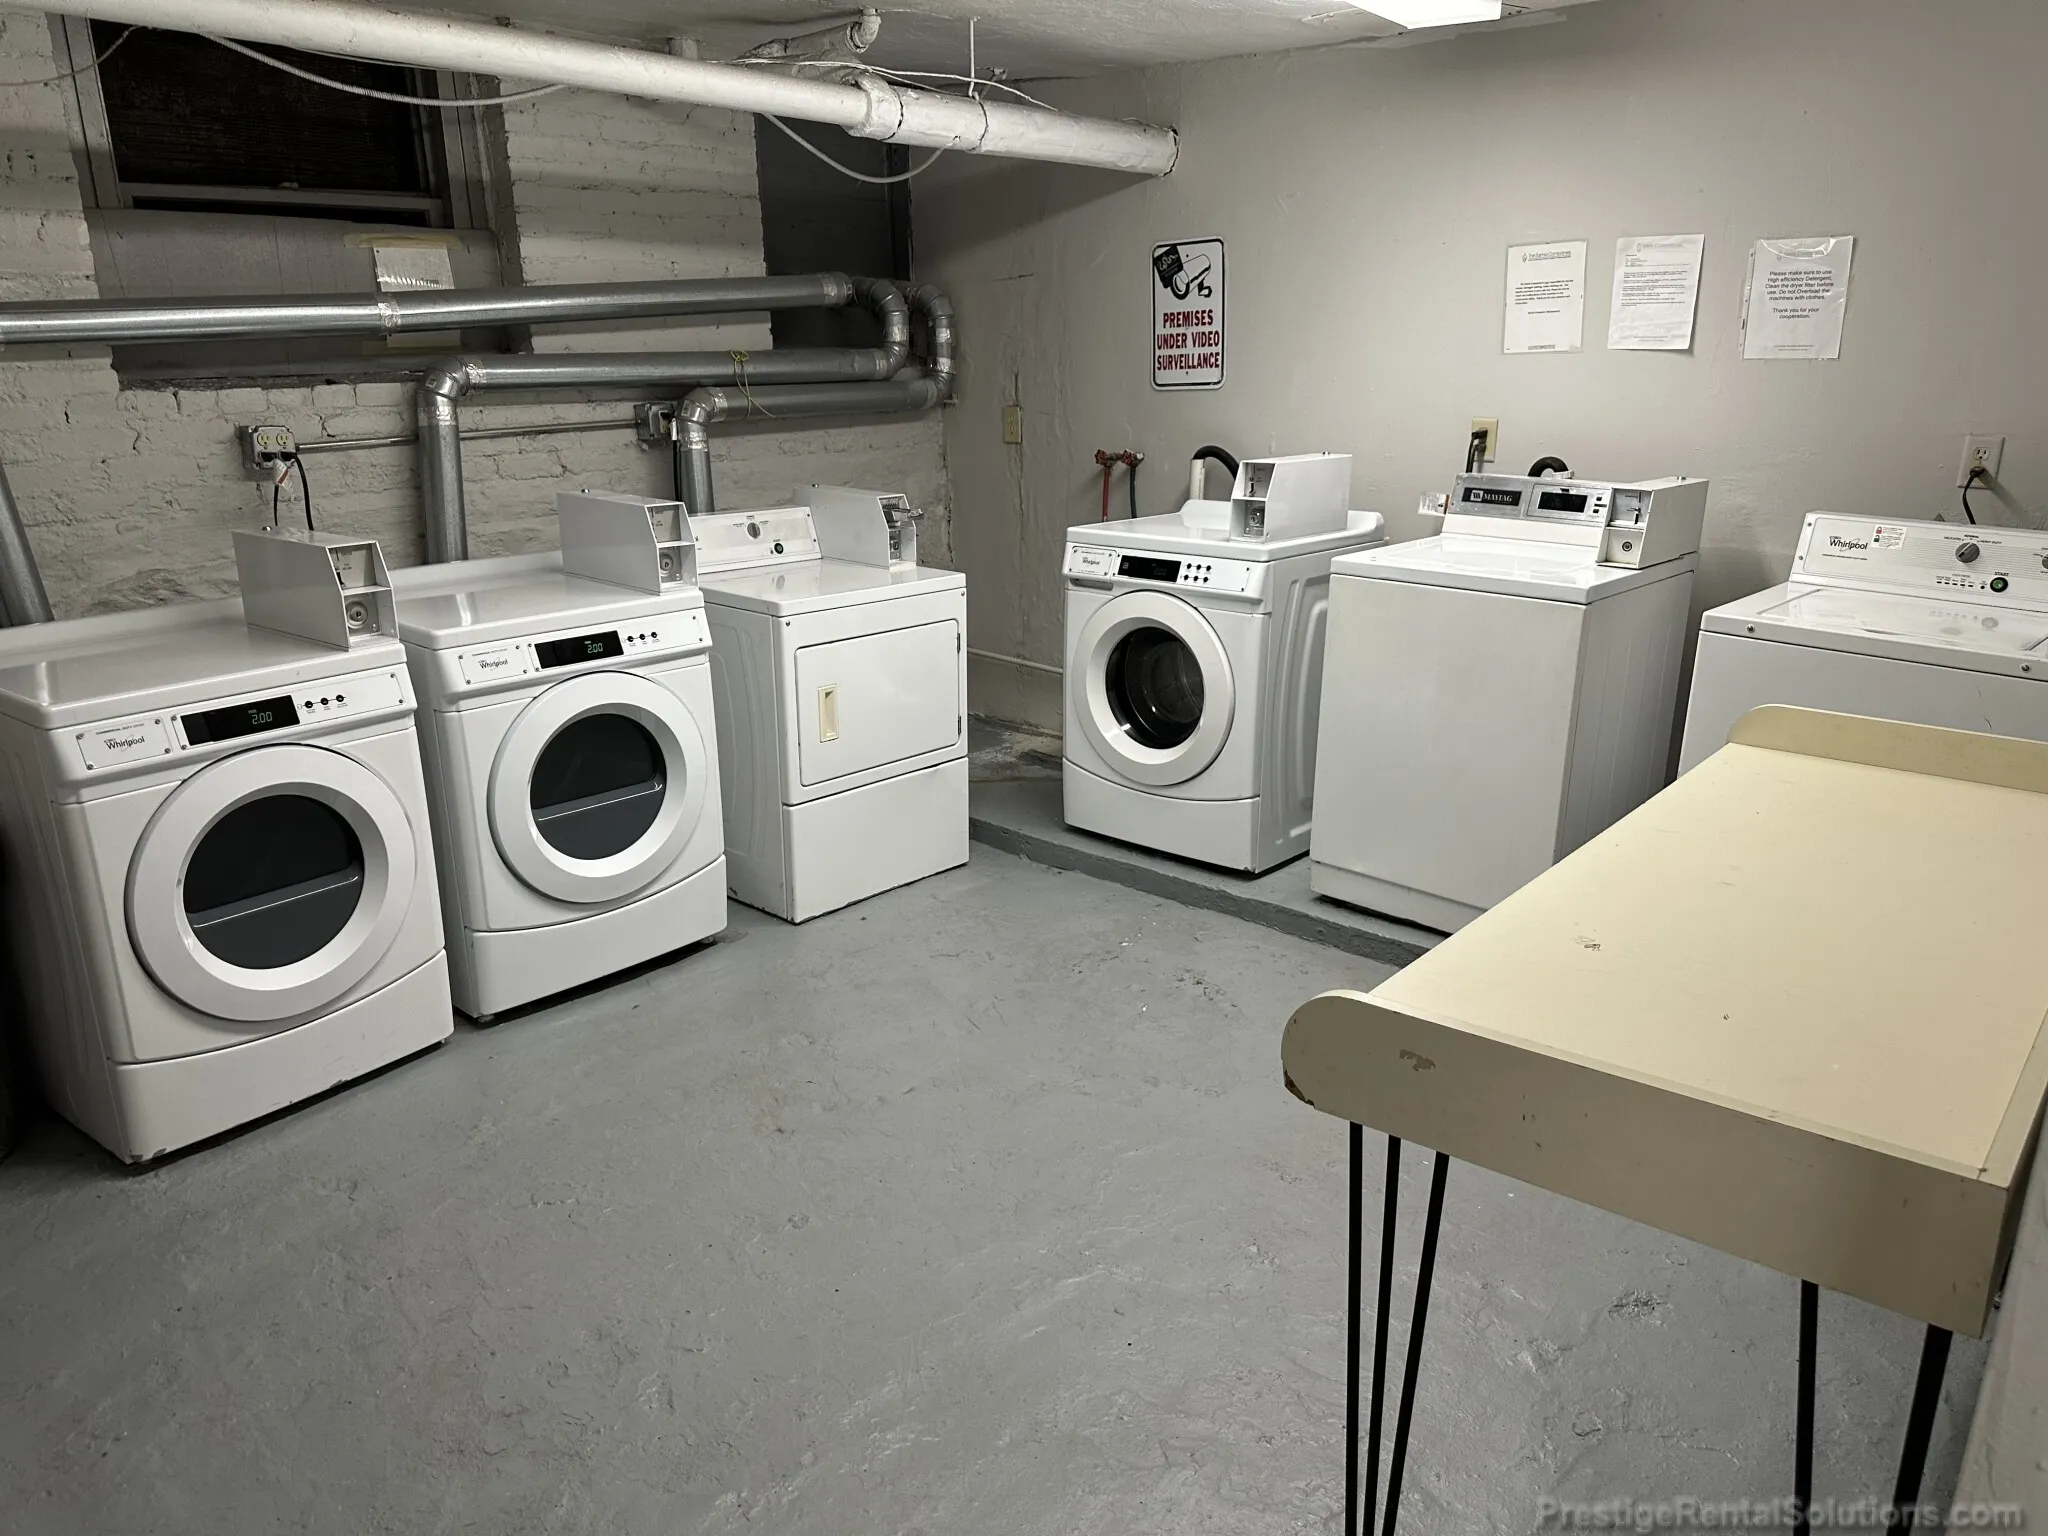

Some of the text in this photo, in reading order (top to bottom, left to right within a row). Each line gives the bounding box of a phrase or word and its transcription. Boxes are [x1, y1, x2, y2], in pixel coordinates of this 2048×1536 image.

[1163, 309, 1213, 328] PREMISES
[1156, 330, 1220, 350] UNDER VIDEO
[1156, 351, 1220, 371] SURVEILLANCE
[1483, 493, 1512, 502] MAYTAG
[1829, 539, 1868, 550] Whirlpool
[479, 659, 508, 669] Whirlpool
[251, 711, 273, 725] 2.00
[104, 736, 145, 750] Whirlpool
